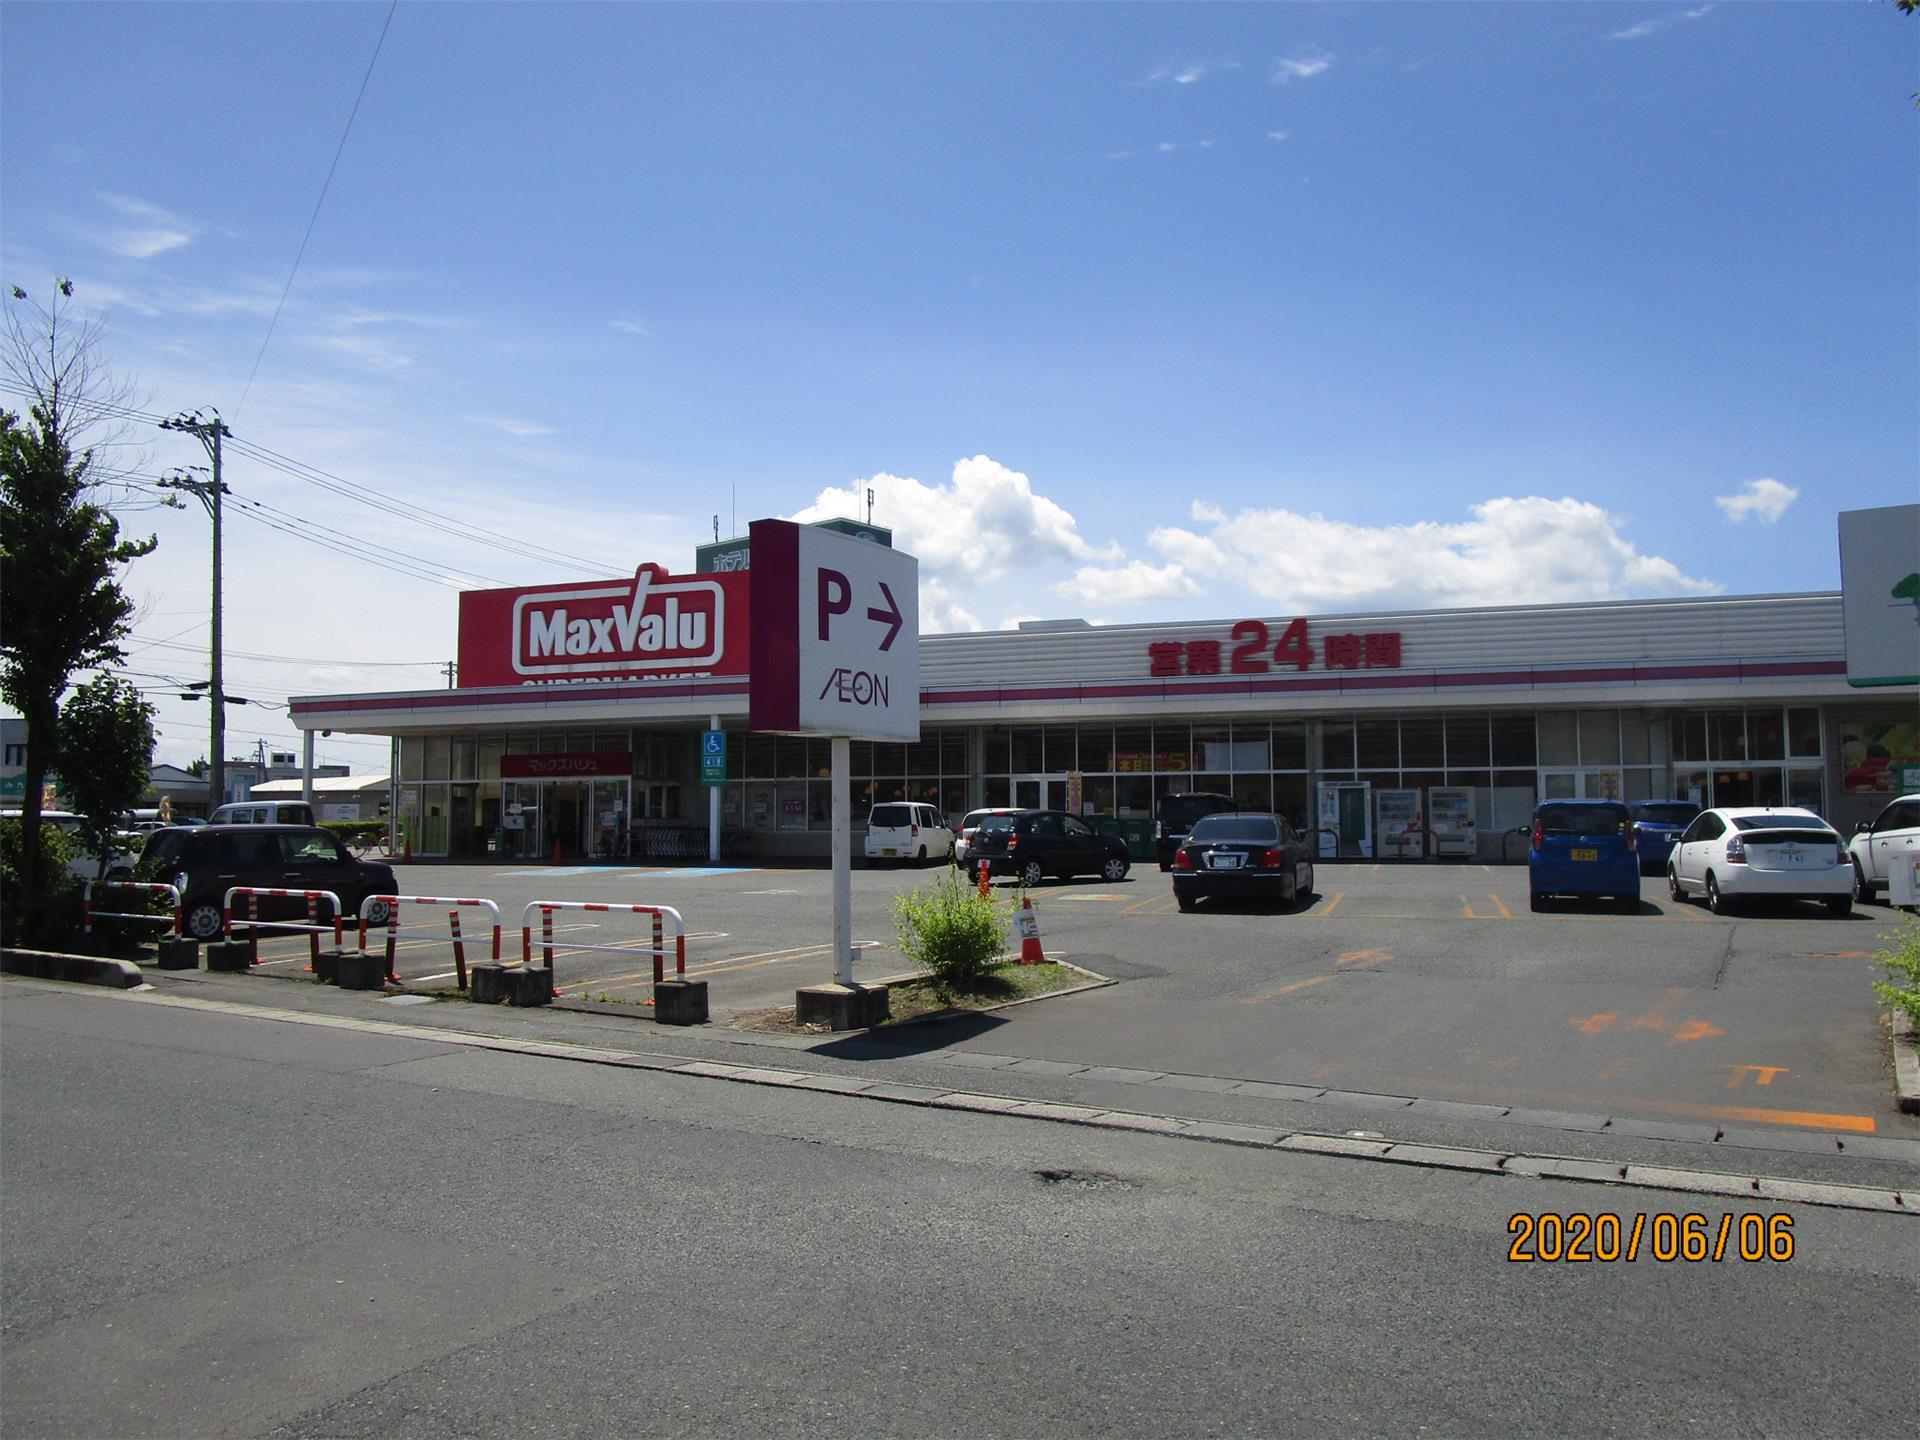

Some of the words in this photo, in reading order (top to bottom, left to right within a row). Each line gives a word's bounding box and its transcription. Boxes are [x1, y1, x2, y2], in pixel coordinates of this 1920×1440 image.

[529, 571, 707, 657] MaxValu
[818, 567, 852, 641] P
[1148, 617, 1401, 677] 営業24時間
